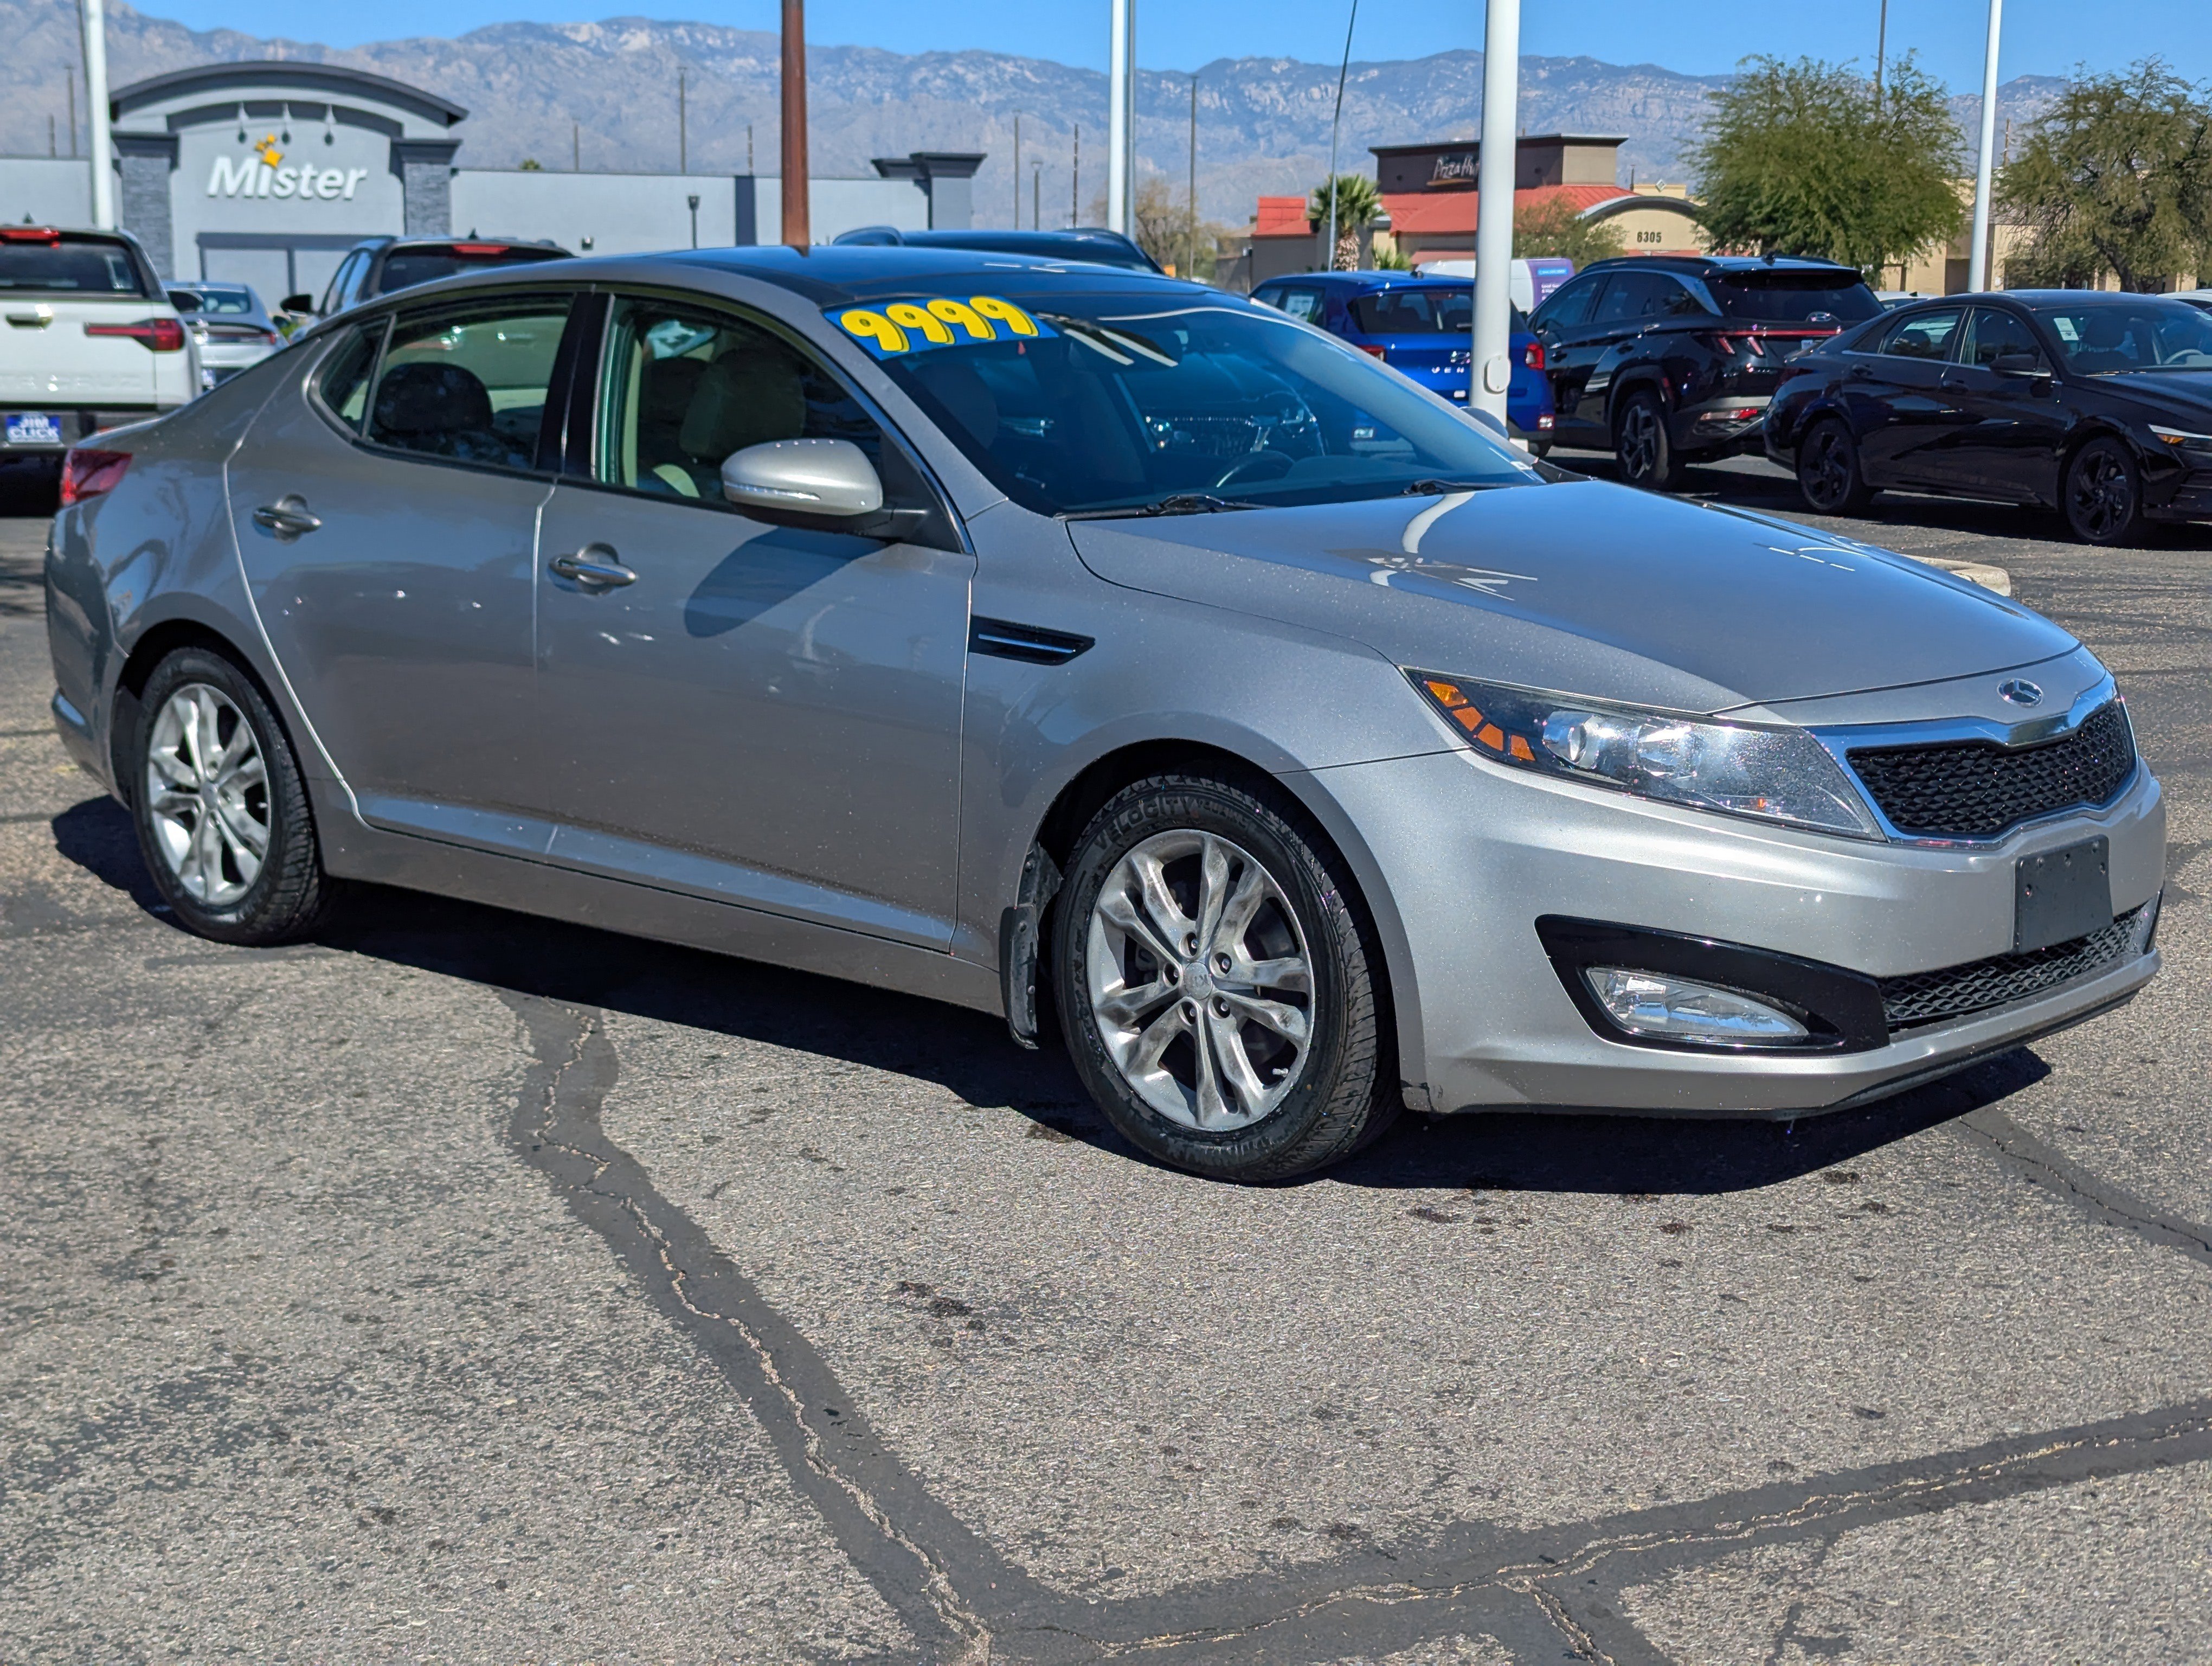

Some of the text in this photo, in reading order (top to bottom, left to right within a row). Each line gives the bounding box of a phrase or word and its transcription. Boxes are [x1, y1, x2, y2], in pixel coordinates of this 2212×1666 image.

[207, 154, 369, 200] Mister
[1432, 156, 1461, 180] Pizza
[1637, 232, 1662, 243] 6305
[840, 296, 1039, 353] 9999
[8, 426, 59, 439] CLICK
[20, 418, 49, 428] JIM
[1092, 795, 1195, 850] VELOCITY
